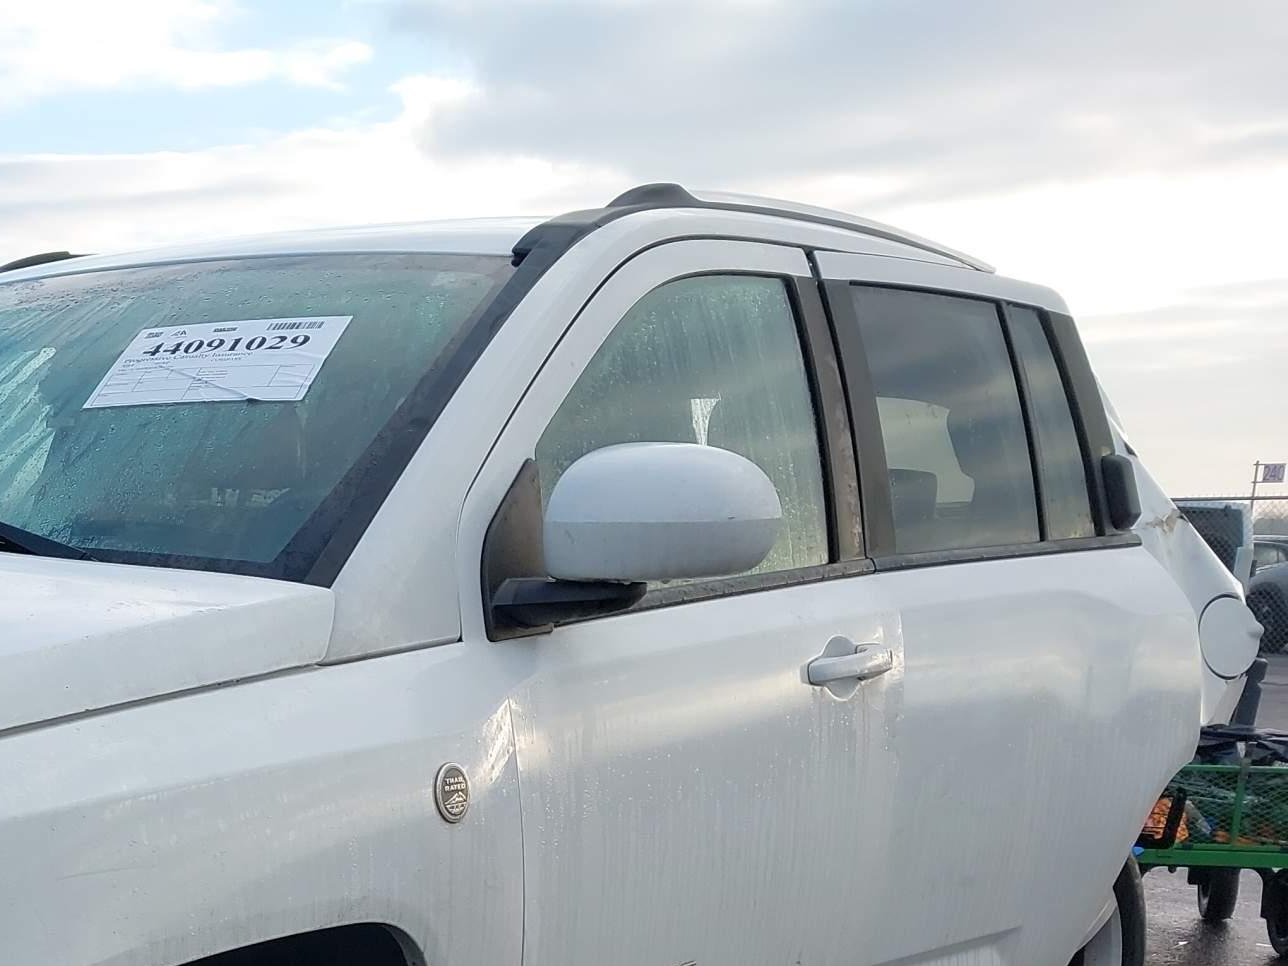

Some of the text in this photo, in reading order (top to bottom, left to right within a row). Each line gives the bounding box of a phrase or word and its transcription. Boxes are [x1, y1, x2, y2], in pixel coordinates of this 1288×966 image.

[143, 334, 311, 357] 44091029
[1263, 464, 1285, 481] 240
[444, 783, 466, 792] RATED
